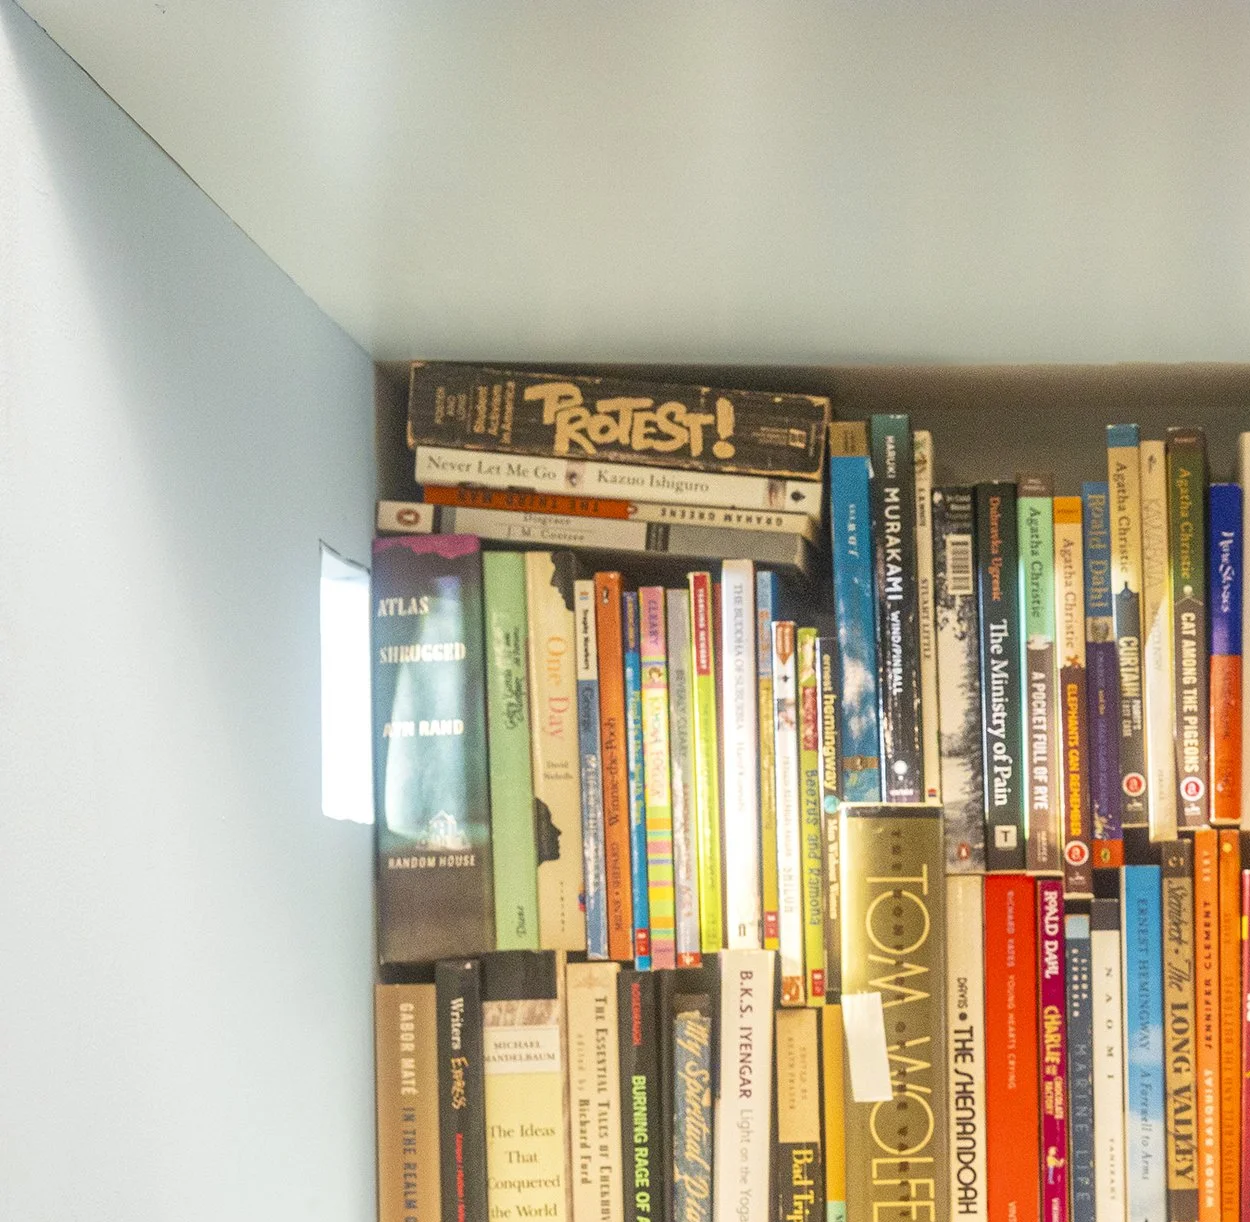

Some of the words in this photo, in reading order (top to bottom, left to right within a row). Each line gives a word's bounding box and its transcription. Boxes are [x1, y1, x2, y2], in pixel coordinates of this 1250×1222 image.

[524, 381, 736, 460] PROTEST!
[427, 455, 473, 475] Never
[478, 460, 500, 477] Let
[505, 462, 527, 478] Me
[532, 463, 557, 481] Go
[597, 470, 643, 489] Kazuo
[648, 474, 709, 496] Ishiguro
[1178, 468, 1192, 518] Agatha
[884, 487, 903, 600] MURAKAMI
[1180, 522, 1193, 579] Christie
[377, 597, 430, 617] ATLAS
[1181, 613, 1196, 637] CAT
[989, 619, 1009, 653] The
[1032, 672, 1045, 680] A
[1182, 640, 1197, 685] AMONG
[987, 657, 1009, 740] Ministry
[1032, 682, 1047, 730] POCKET
[1183, 688, 1198, 710] THE
[993, 743, 1011, 763] of
[1033, 733, 1048, 763] FULL
[1184, 714, 1200, 772] PIGEONS
[994, 766, 1011, 805] Pain
[1033, 766, 1048, 783] OF
[1034, 786, 1049, 810] RYE
[1044, 891, 1059, 935] ROALD
[865, 864, 930, 1008] TOM
[1045, 940, 1060, 978] DAHL
[739, 970, 753, 1018] B.K.S.
[400, 1003, 414, 1050] GABOR
[955, 1026, 973, 1063] THE
[1171, 1002, 1192, 1073] LONG
[739, 1027, 752, 1099] IYENGAR
[402, 1107, 416, 1123] IN
[631, 1075, 649, 1143] BURNING
[403, 1129, 417, 1156] THE
[489, 1125, 514, 1138] The
[519, 1124, 556, 1138] Ideas
[954, 1068, 977, 1214] SHENANDOAH
[1173, 1083, 1197, 1182] VALLEY
[506, 1151, 538, 1164] That
[634, 1147, 649, 1188] RAGE
[793, 1149, 814, 1185] Bad
[403, 1162, 417, 1210] REALM
[634, 1193, 650, 1212] OF
[491, 1204, 511, 1218] the
[516, 1203, 558, 1218] World
